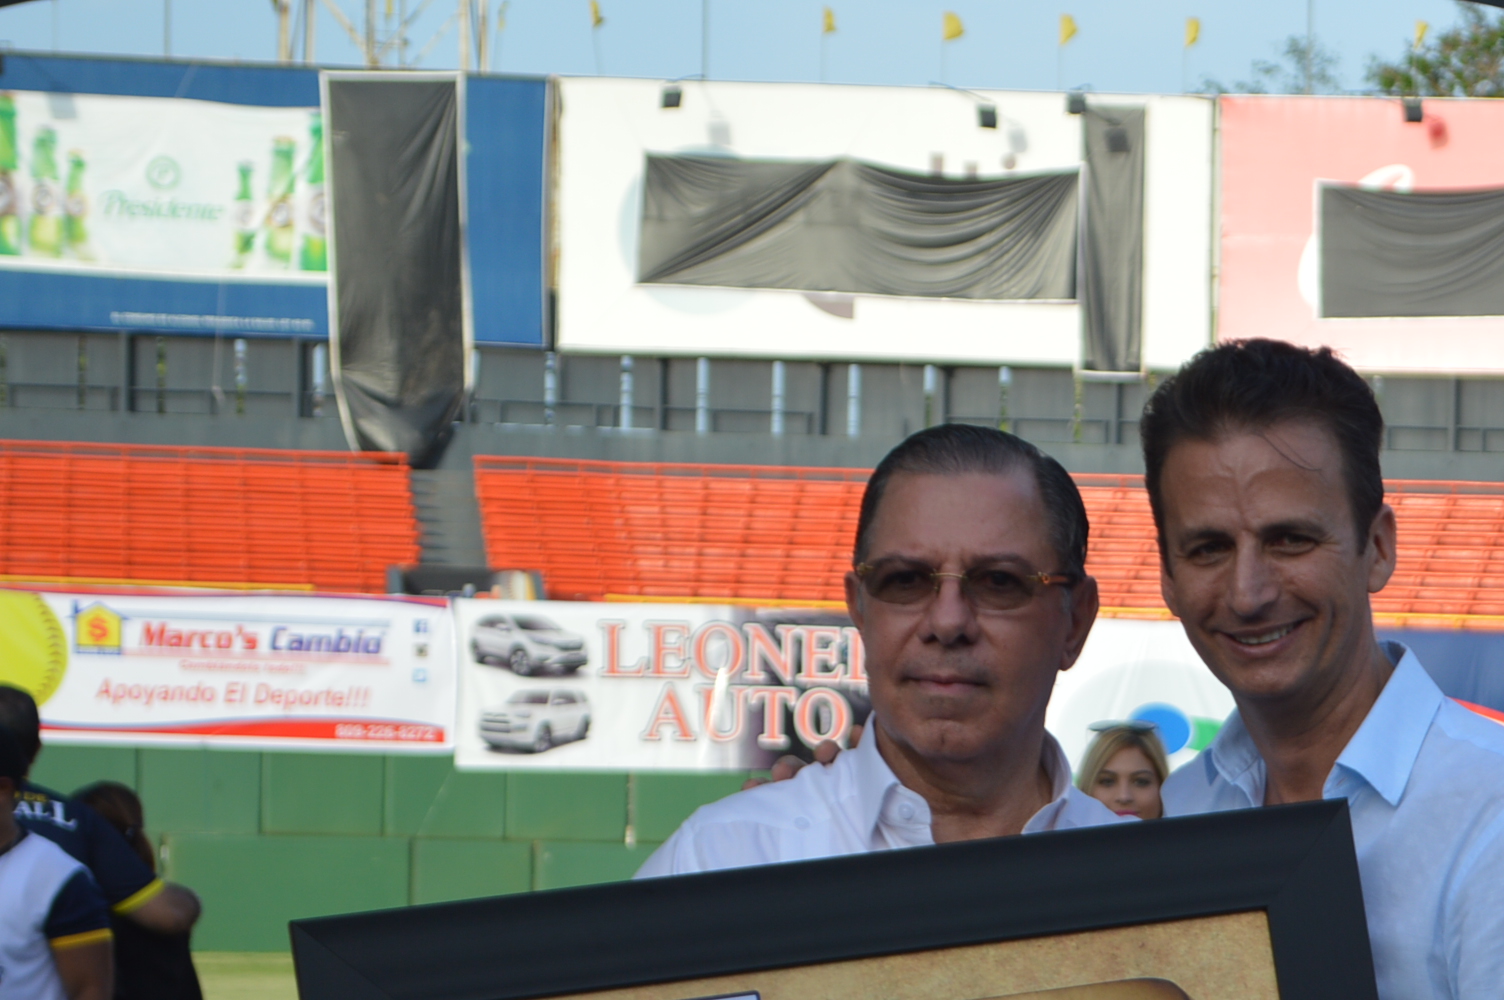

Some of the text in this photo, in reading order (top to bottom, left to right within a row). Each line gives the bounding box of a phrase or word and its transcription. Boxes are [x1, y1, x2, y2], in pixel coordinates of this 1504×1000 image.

[139, 622, 386, 654] Marco's Cambio
[96, 679, 371, 711] Apoyando El Deporte!!!
[642, 683, 853, 750] AUTO
